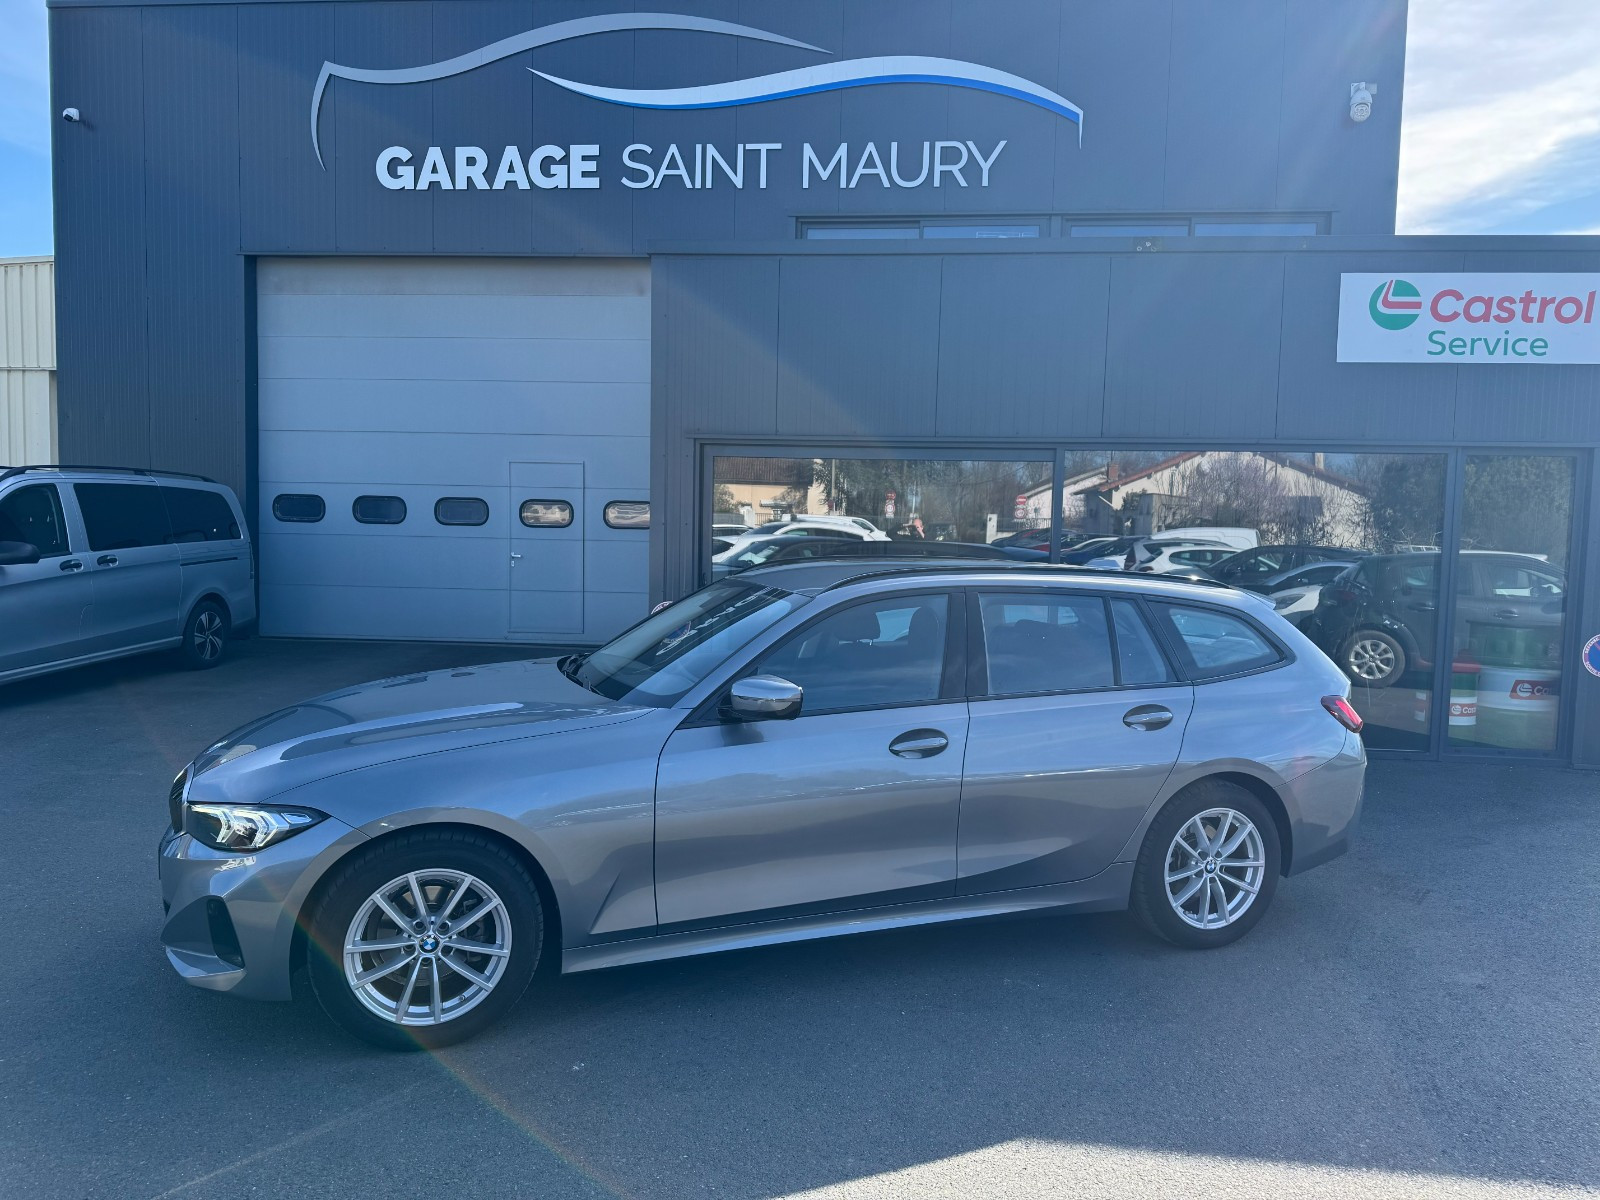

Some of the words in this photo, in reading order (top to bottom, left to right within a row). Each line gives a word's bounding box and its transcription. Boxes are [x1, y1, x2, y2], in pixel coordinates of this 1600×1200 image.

[375, 144, 600, 190] GARAGE
[620, 143, 782, 189] SAINT
[802, 140, 1008, 189] MAURY
[1429, 288, 1597, 325] Castrol
[1426, 330, 1549, 357] Service
